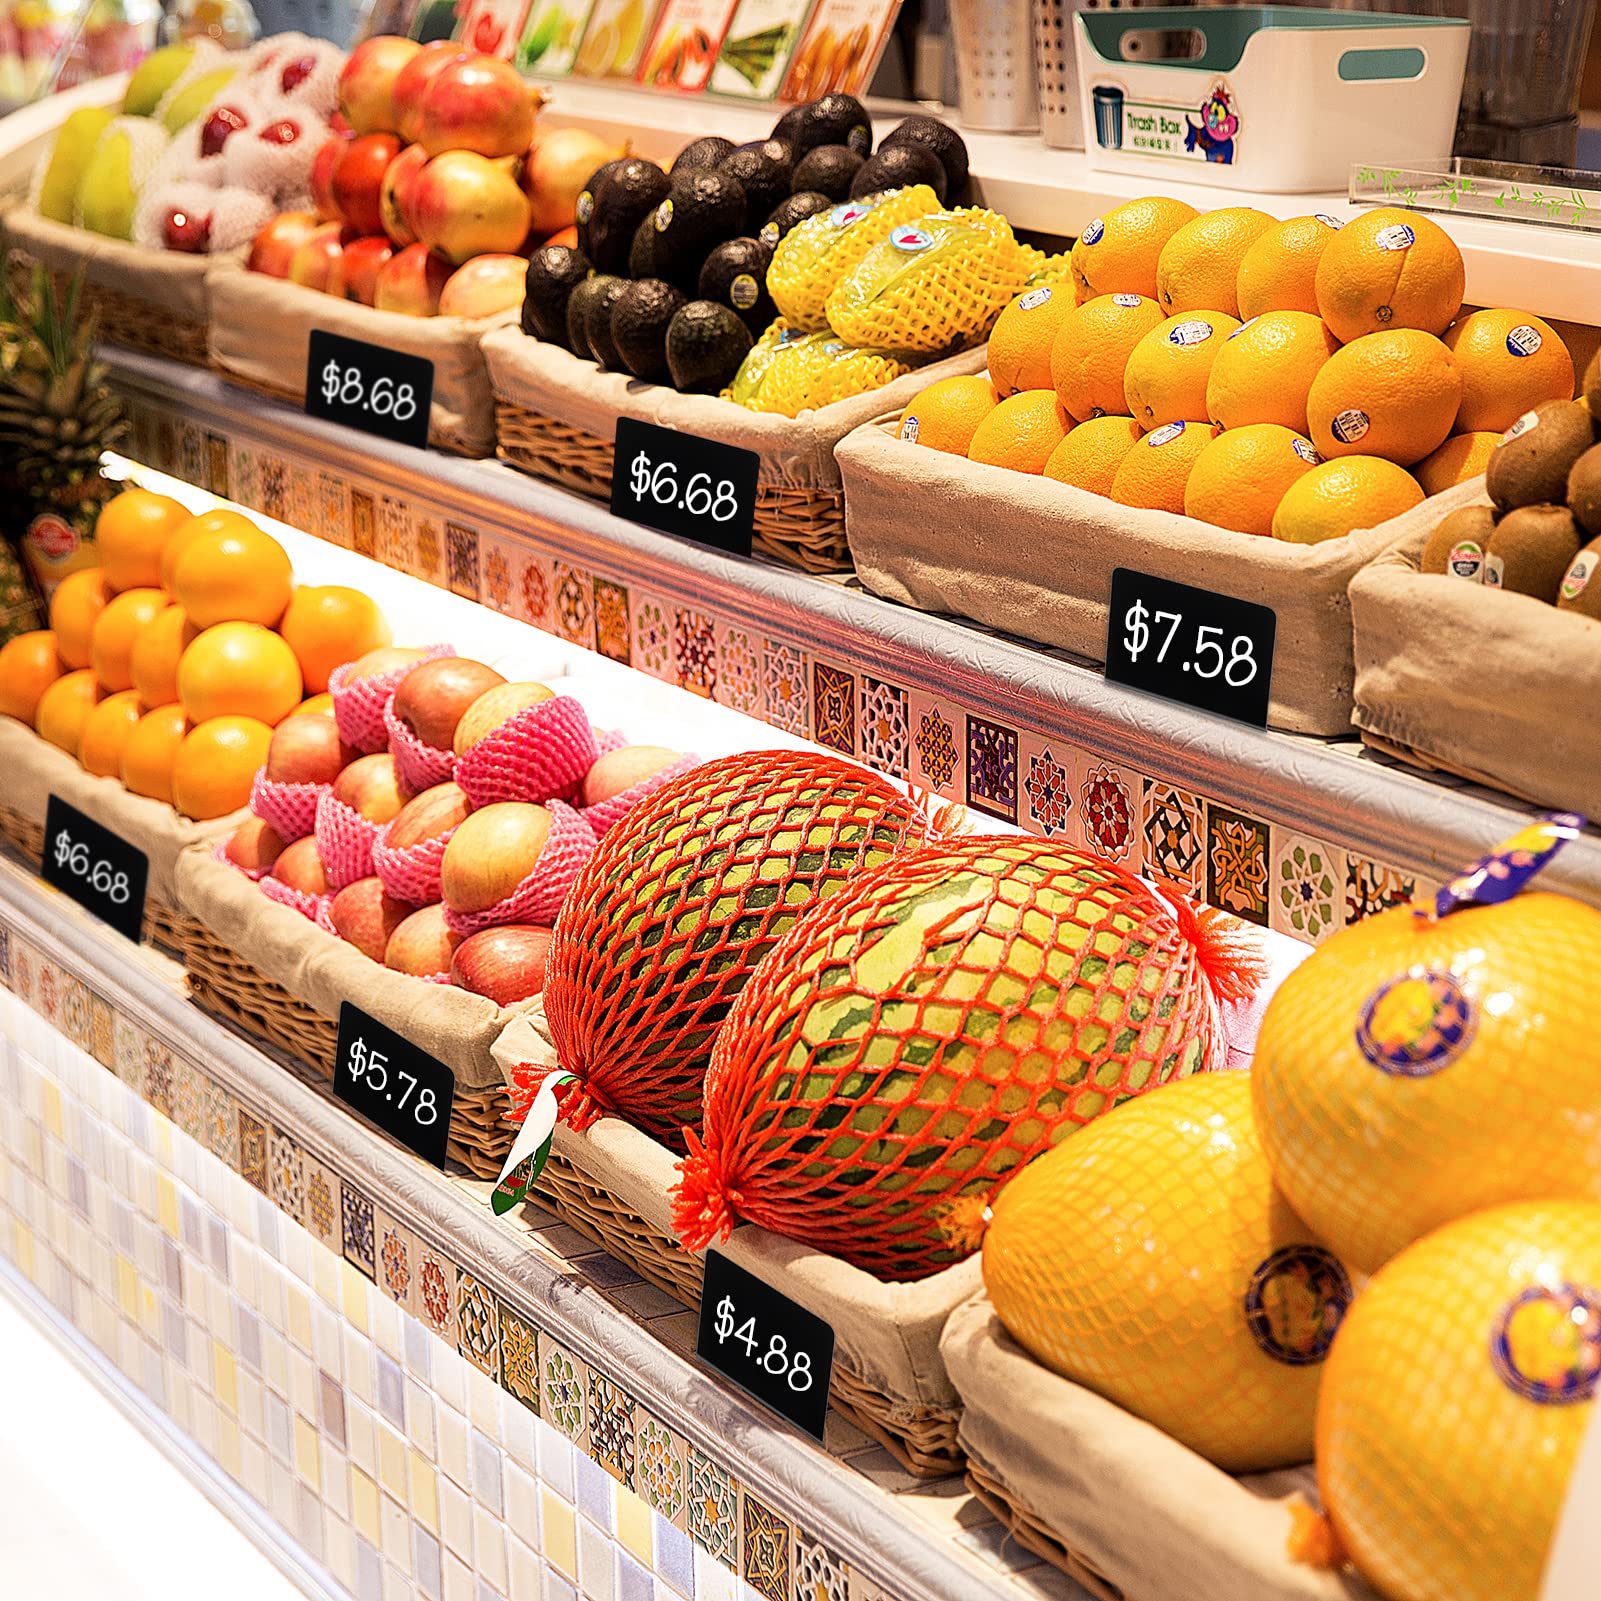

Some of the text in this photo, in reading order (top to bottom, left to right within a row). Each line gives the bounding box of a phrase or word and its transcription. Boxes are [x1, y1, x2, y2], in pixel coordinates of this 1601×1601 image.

[1127, 112, 1158, 132] Trash
[322, 360, 416, 420] $8.68
[630, 451, 737, 521] $6.68
[1124, 599, 1257, 686] $7.58
[54, 829, 130, 904] $6.68
[348, 1037, 438, 1125] $5.78
[715, 1295, 812, 1391] $4.88
